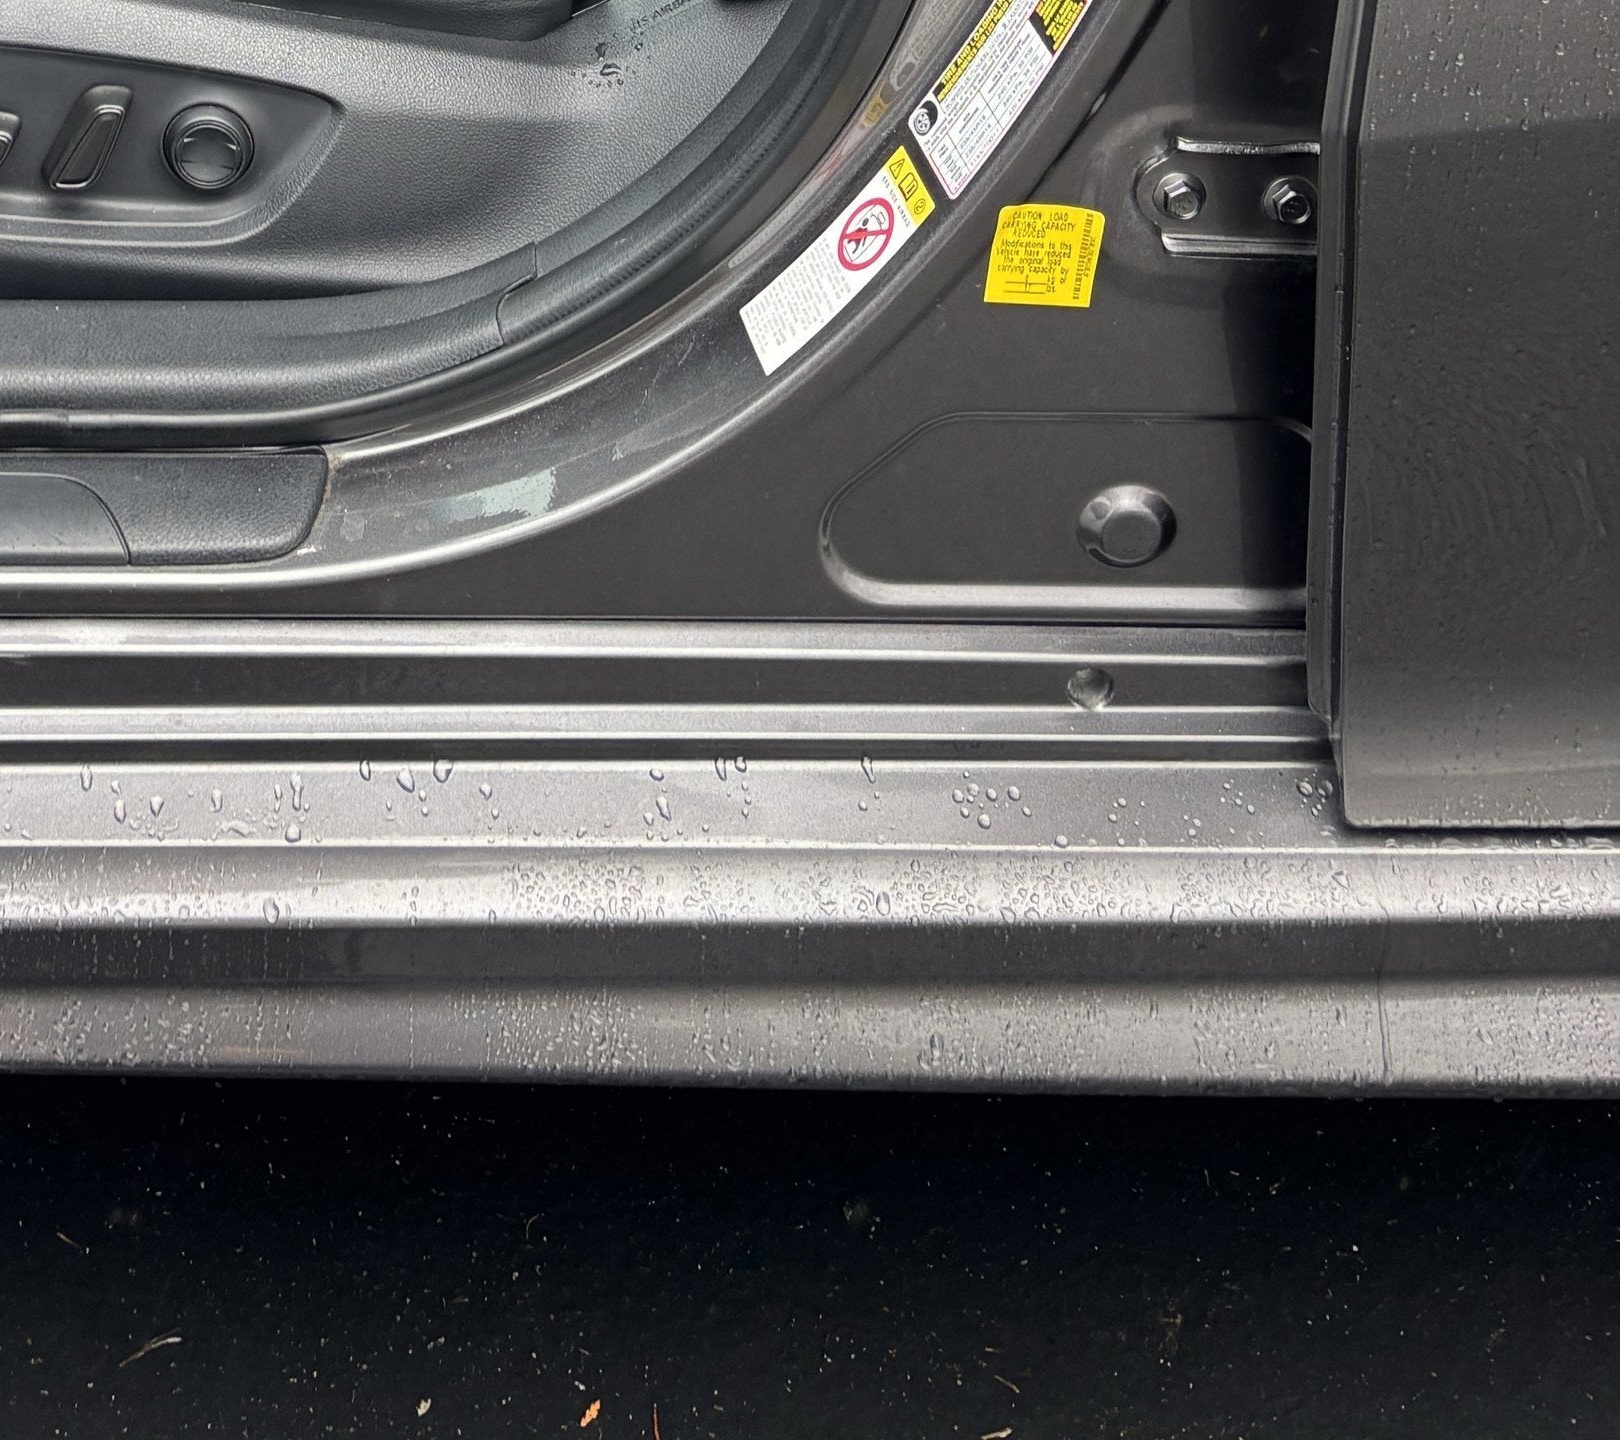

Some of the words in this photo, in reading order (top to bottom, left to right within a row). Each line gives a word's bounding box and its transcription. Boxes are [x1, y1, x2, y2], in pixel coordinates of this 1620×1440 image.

[940, 63, 956, 87] TIRE
[955, 43, 971, 68] AND
[968, 3, 999, 48] LOADING
[1012, 211, 1042, 220] CAUTION
[1050, 212, 1069, 222] LOAD
[1041, 223, 1076, 232] CAPACITY
